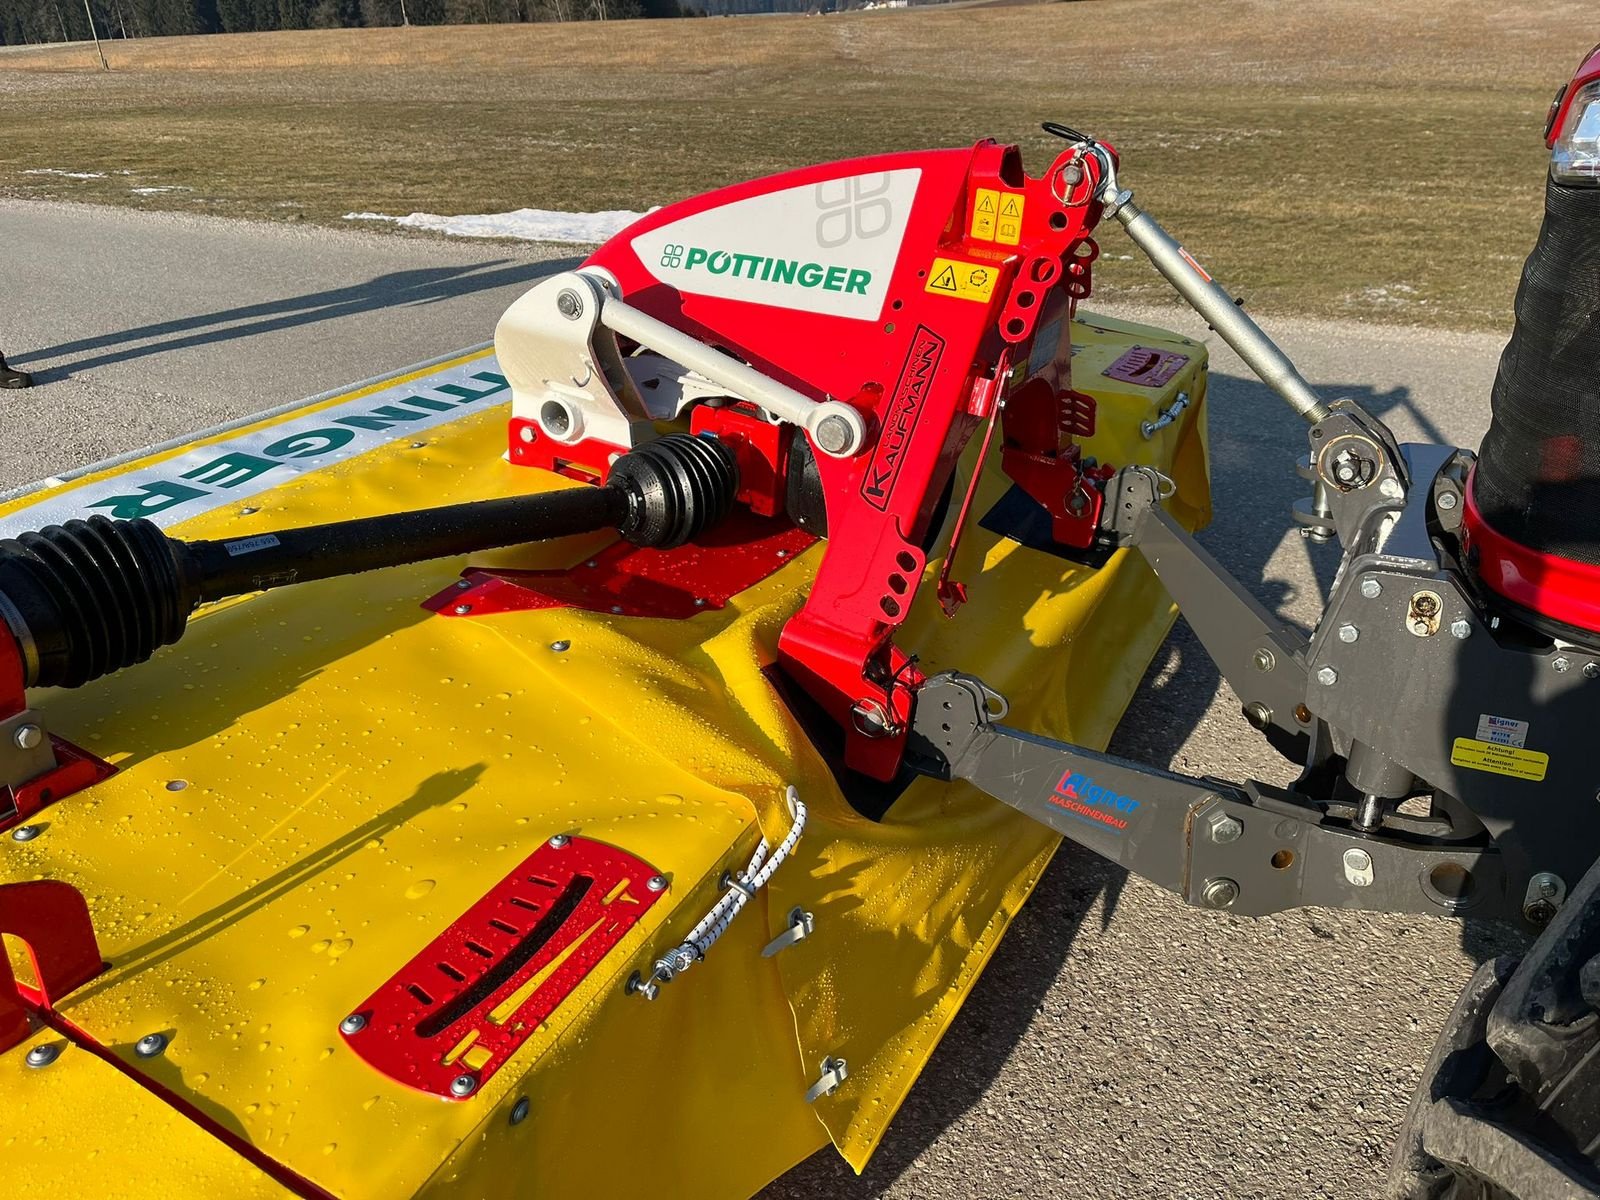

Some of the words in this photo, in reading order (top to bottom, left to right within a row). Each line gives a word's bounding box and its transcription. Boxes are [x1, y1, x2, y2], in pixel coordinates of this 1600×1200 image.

[684, 247, 872, 295] PÖTTINGER
[882, 340, 926, 447] LANDMASCHINEN
[866, 339, 940, 498] KAUFMANN
[83, 371, 511, 519] TTINGER
[1482, 757, 1514, 768] Attention!
[1486, 745, 1515, 756] Achtung!
[1048, 795, 1128, 830] MASCHINENBAU
